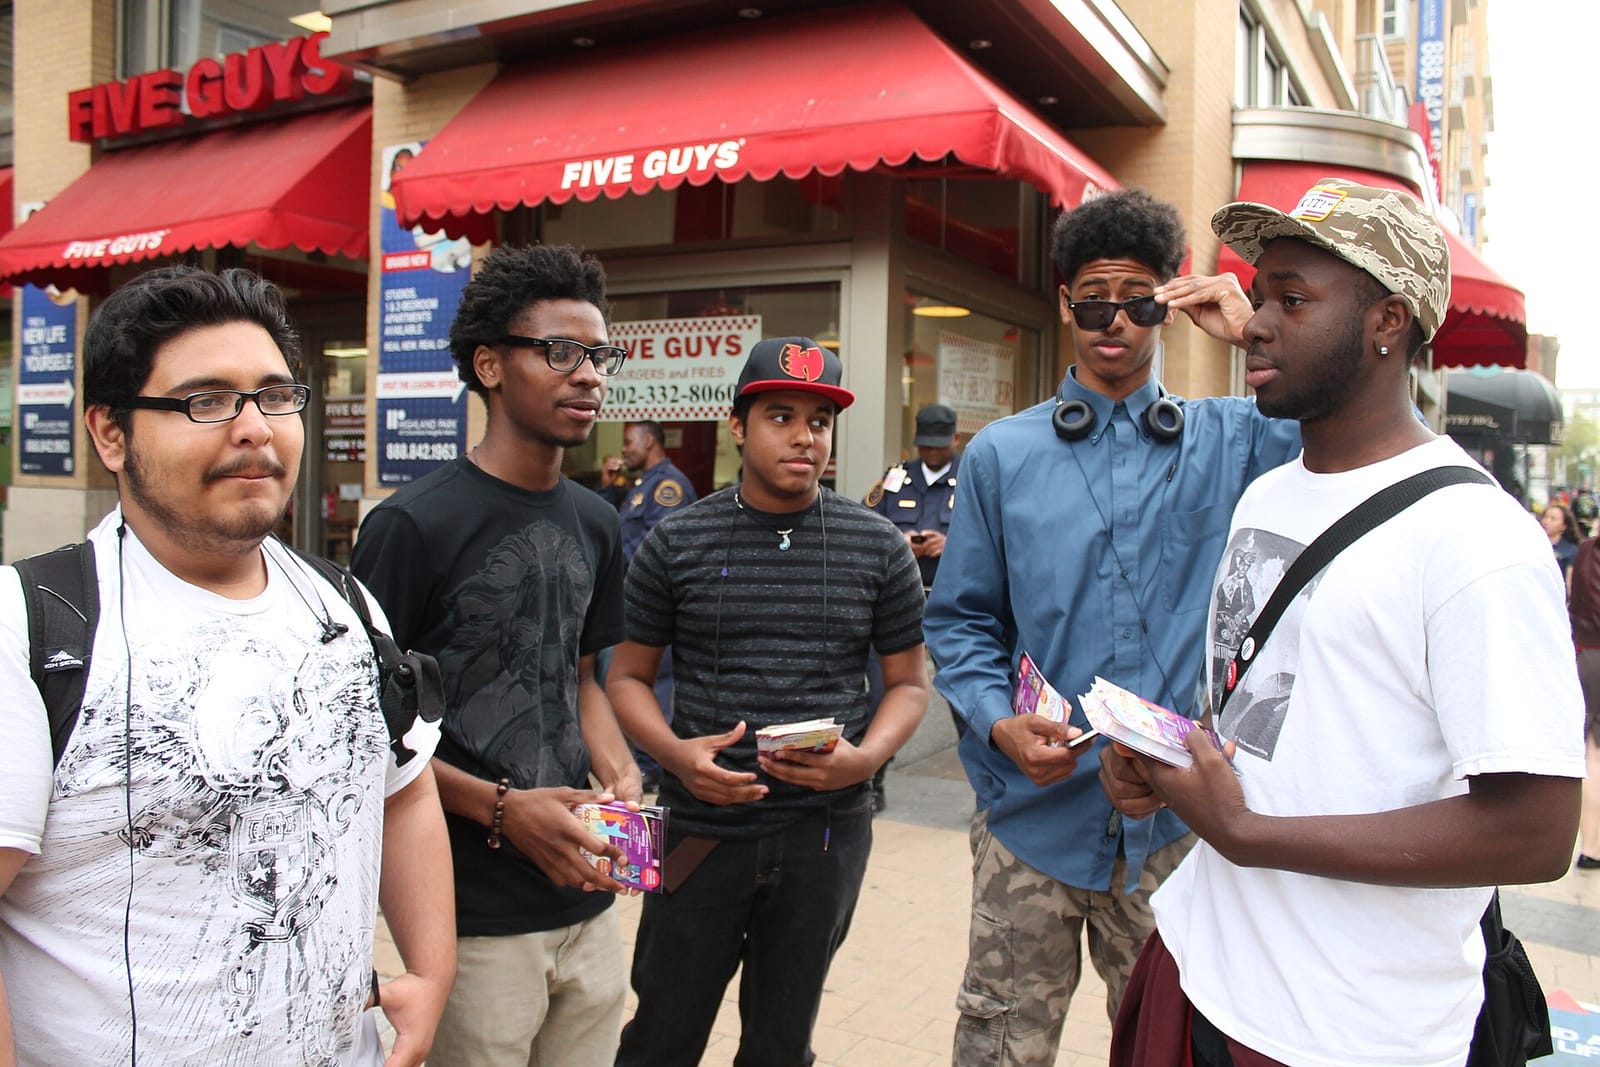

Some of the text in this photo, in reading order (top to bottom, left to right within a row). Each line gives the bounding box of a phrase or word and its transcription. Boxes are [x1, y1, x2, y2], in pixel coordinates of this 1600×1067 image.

[68, 31, 343, 142] FIVE GUYS
[561, 141, 741, 189] FIVE GUYS
[63, 230, 166, 259] FIVE GUYS
[615, 334, 742, 359] VE GUYS
[669, 369, 688, 379] and
[691, 367, 725, 378] FRIES
[606, 384, 736, 404] 202-332-8060
[325, 403, 365, 416] FIVE GU
